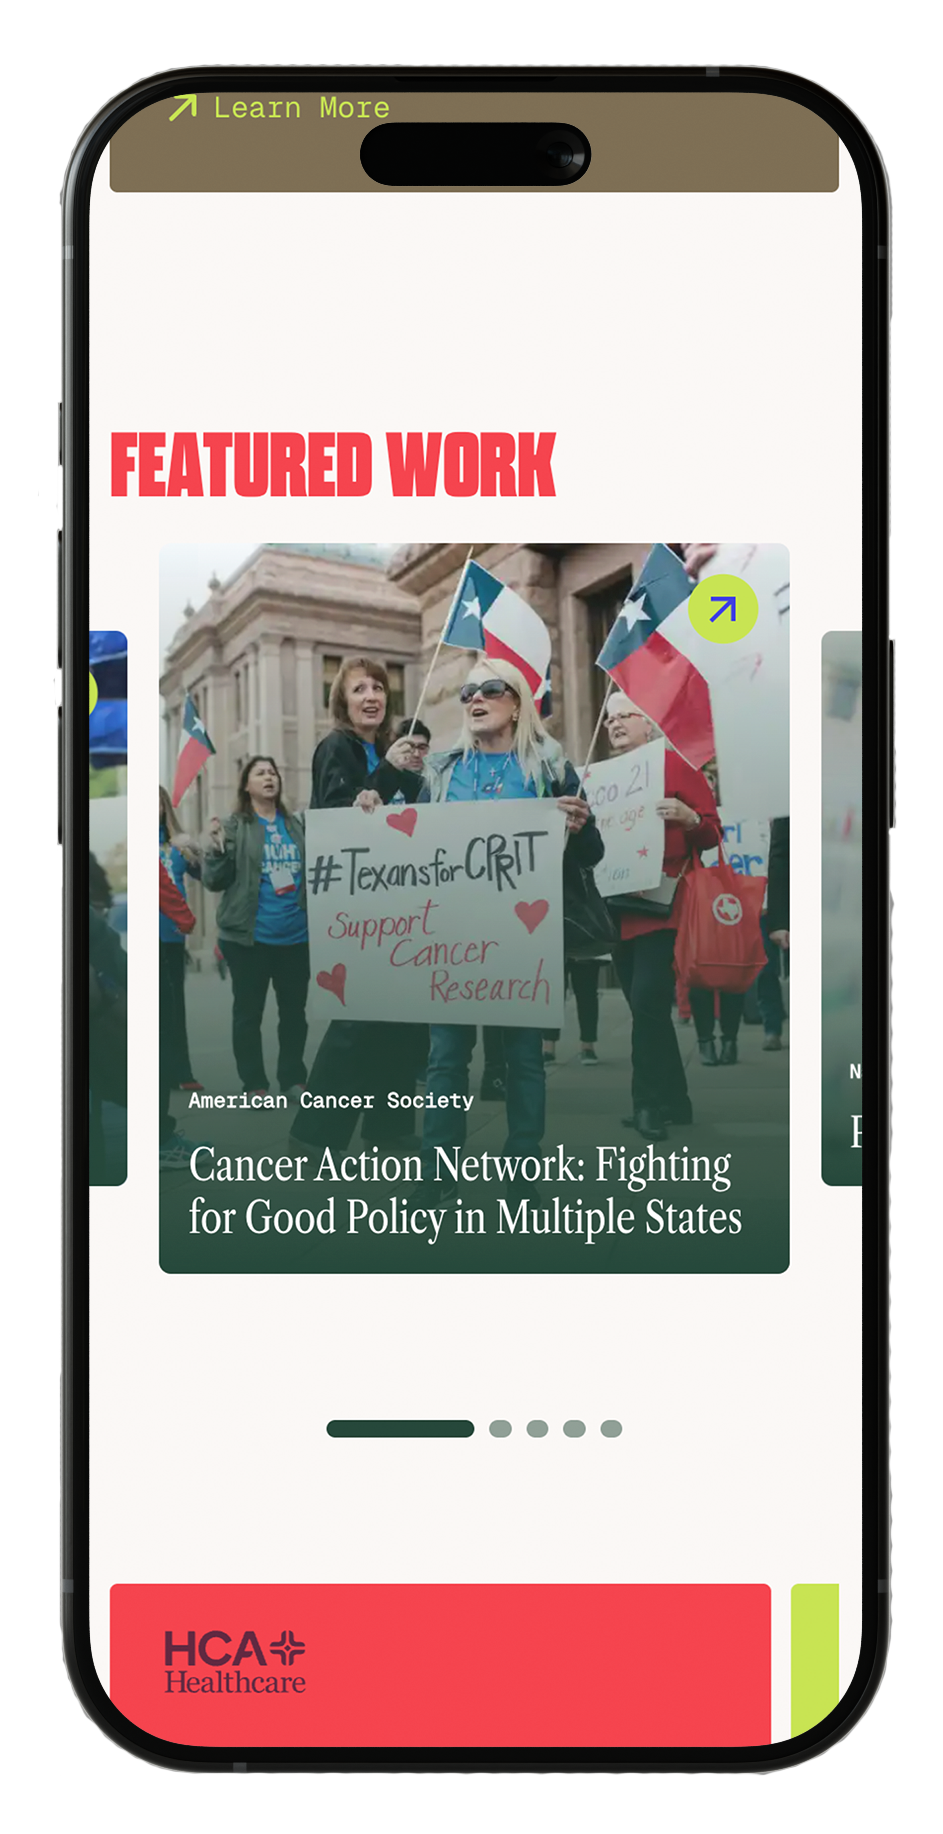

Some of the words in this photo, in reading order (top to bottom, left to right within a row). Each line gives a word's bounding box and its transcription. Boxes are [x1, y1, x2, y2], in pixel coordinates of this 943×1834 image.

[215, 96, 301, 119] Learn
[320, 96, 390, 119] More
[110, 431, 373, 498] FEATURED
[385, 431, 557, 498] WORK
[328, 899, 440, 950] Support
[390, 939, 499, 967] Cancer
[430, 958, 550, 1006] Research
[188, 1091, 288, 1109] American
[300, 1091, 375, 1109] Cancer
[387, 1091, 474, 1112] Society
[189, 1145, 308, 1182] Cancer
[314, 1145, 424, 1182] Action
[433, 1144, 585, 1182] Network:
[596, 1144, 732, 1192] Fighting
[189, 1197, 236, 1234] for
[245, 1197, 336, 1234] Good
[346, 1197, 448, 1245] Policy
[454, 1198, 487, 1234] in
[496, 1197, 635, 1245] Multiple
[646, 1198, 742, 1234] States
[164, 1630, 268, 1667] HCA
[164, 1670, 306, 1694] Healthcare
